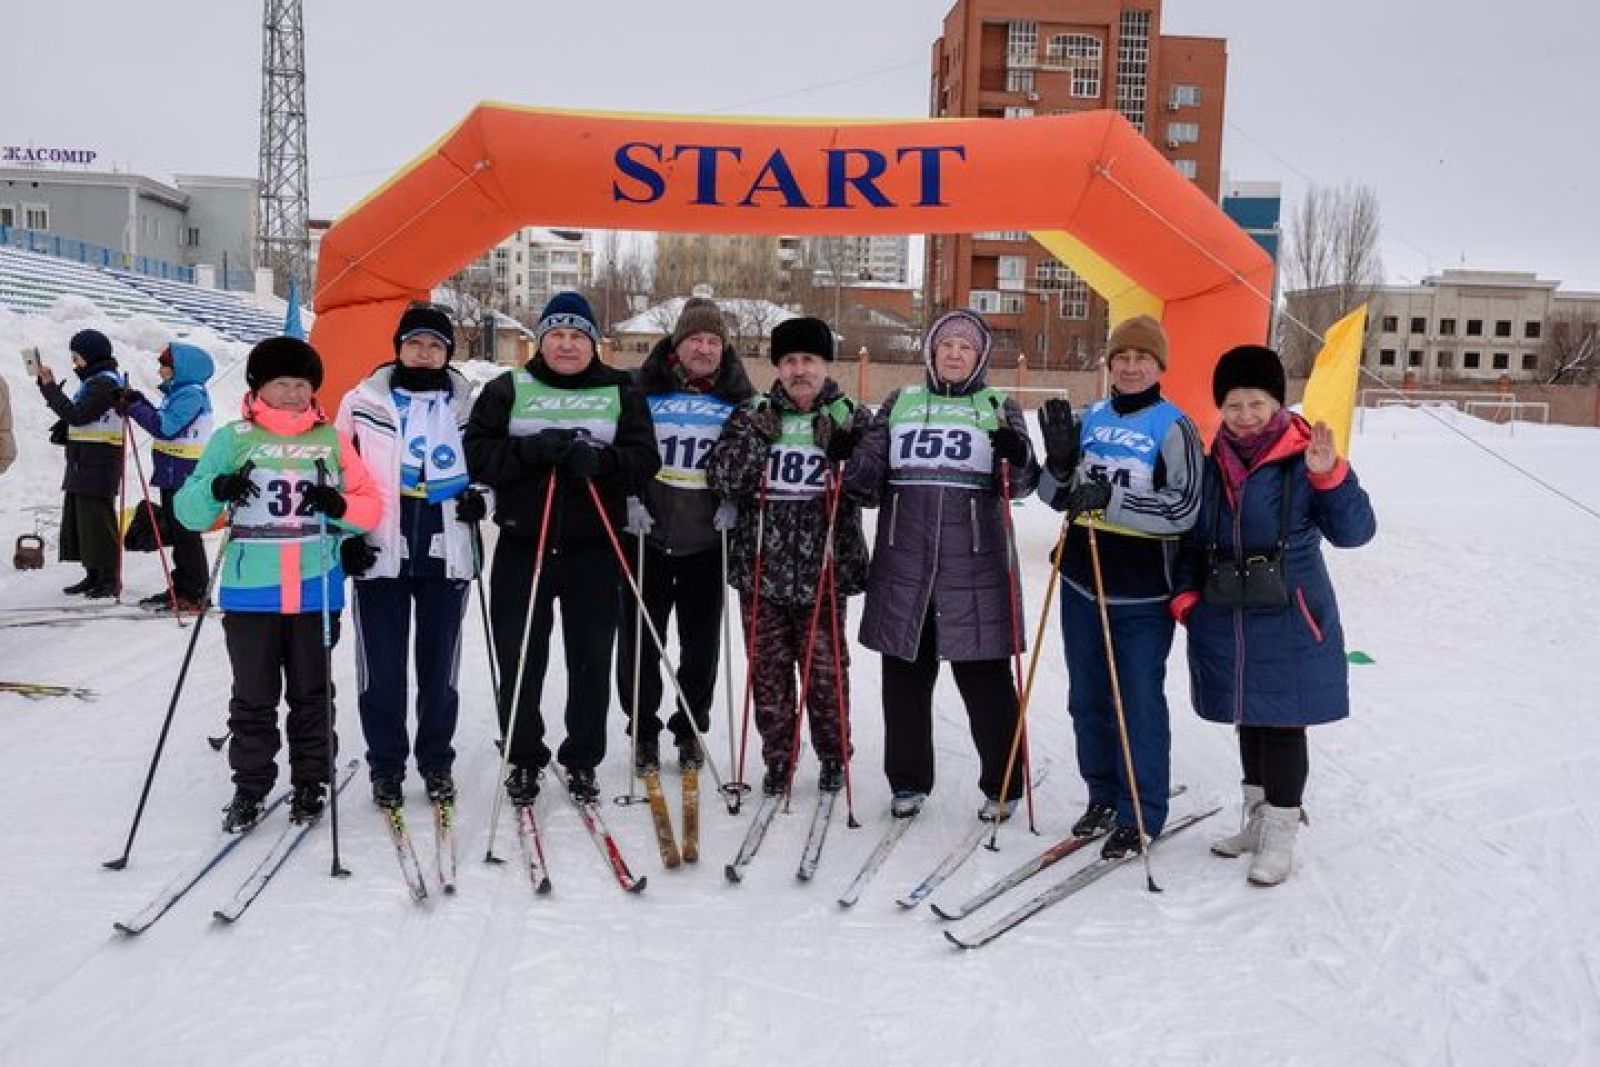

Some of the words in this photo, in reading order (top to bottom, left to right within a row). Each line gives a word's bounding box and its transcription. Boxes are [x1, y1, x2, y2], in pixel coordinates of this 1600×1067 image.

[612, 141, 966, 208] START
[660, 435, 713, 469] 112
[898, 428, 972, 460] 153
[769, 450, 827, 485] 182
[267, 479, 314, 517] 32
